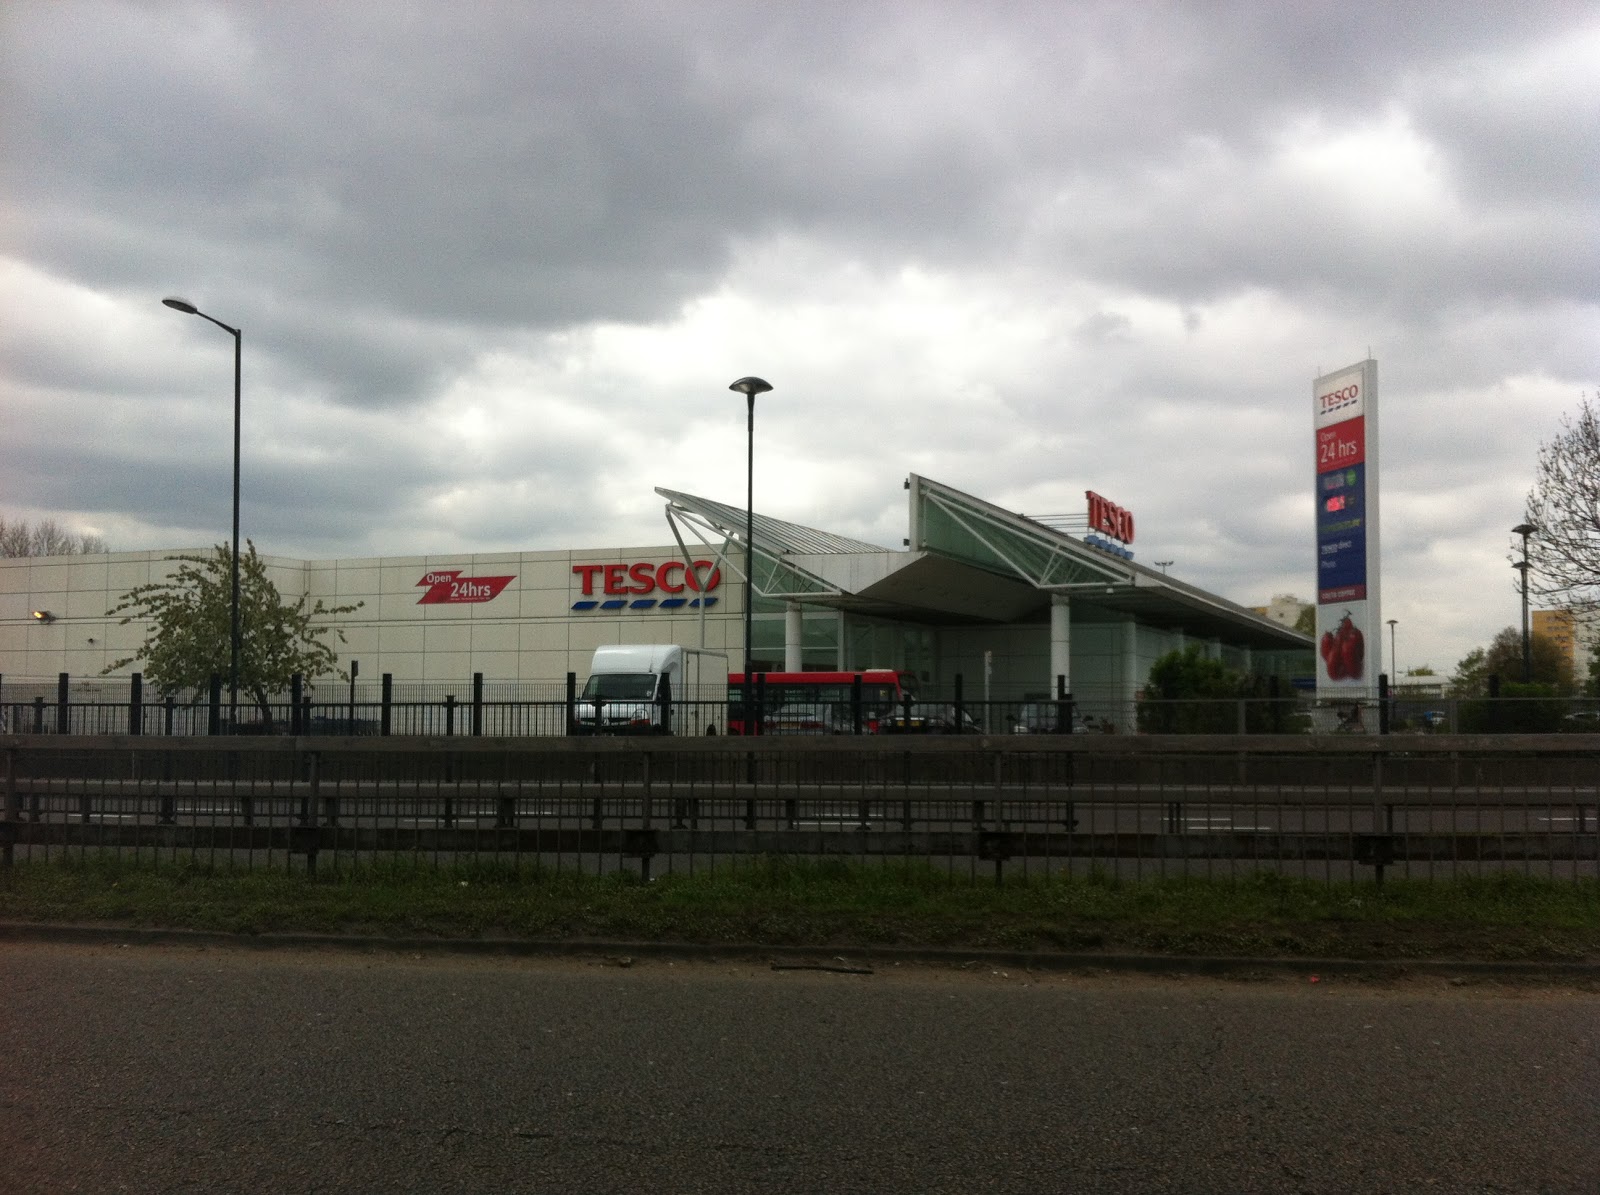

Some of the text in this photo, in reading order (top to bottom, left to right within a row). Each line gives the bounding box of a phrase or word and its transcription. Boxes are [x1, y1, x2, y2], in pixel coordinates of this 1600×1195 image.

[1320, 384, 1358, 409] TESCO
[1320, 439, 1357, 463] 24 hrs
[426, 573, 452, 585] Open
[572, 560, 721, 595] TESCO
[450, 582, 491, 598] 24hrs
